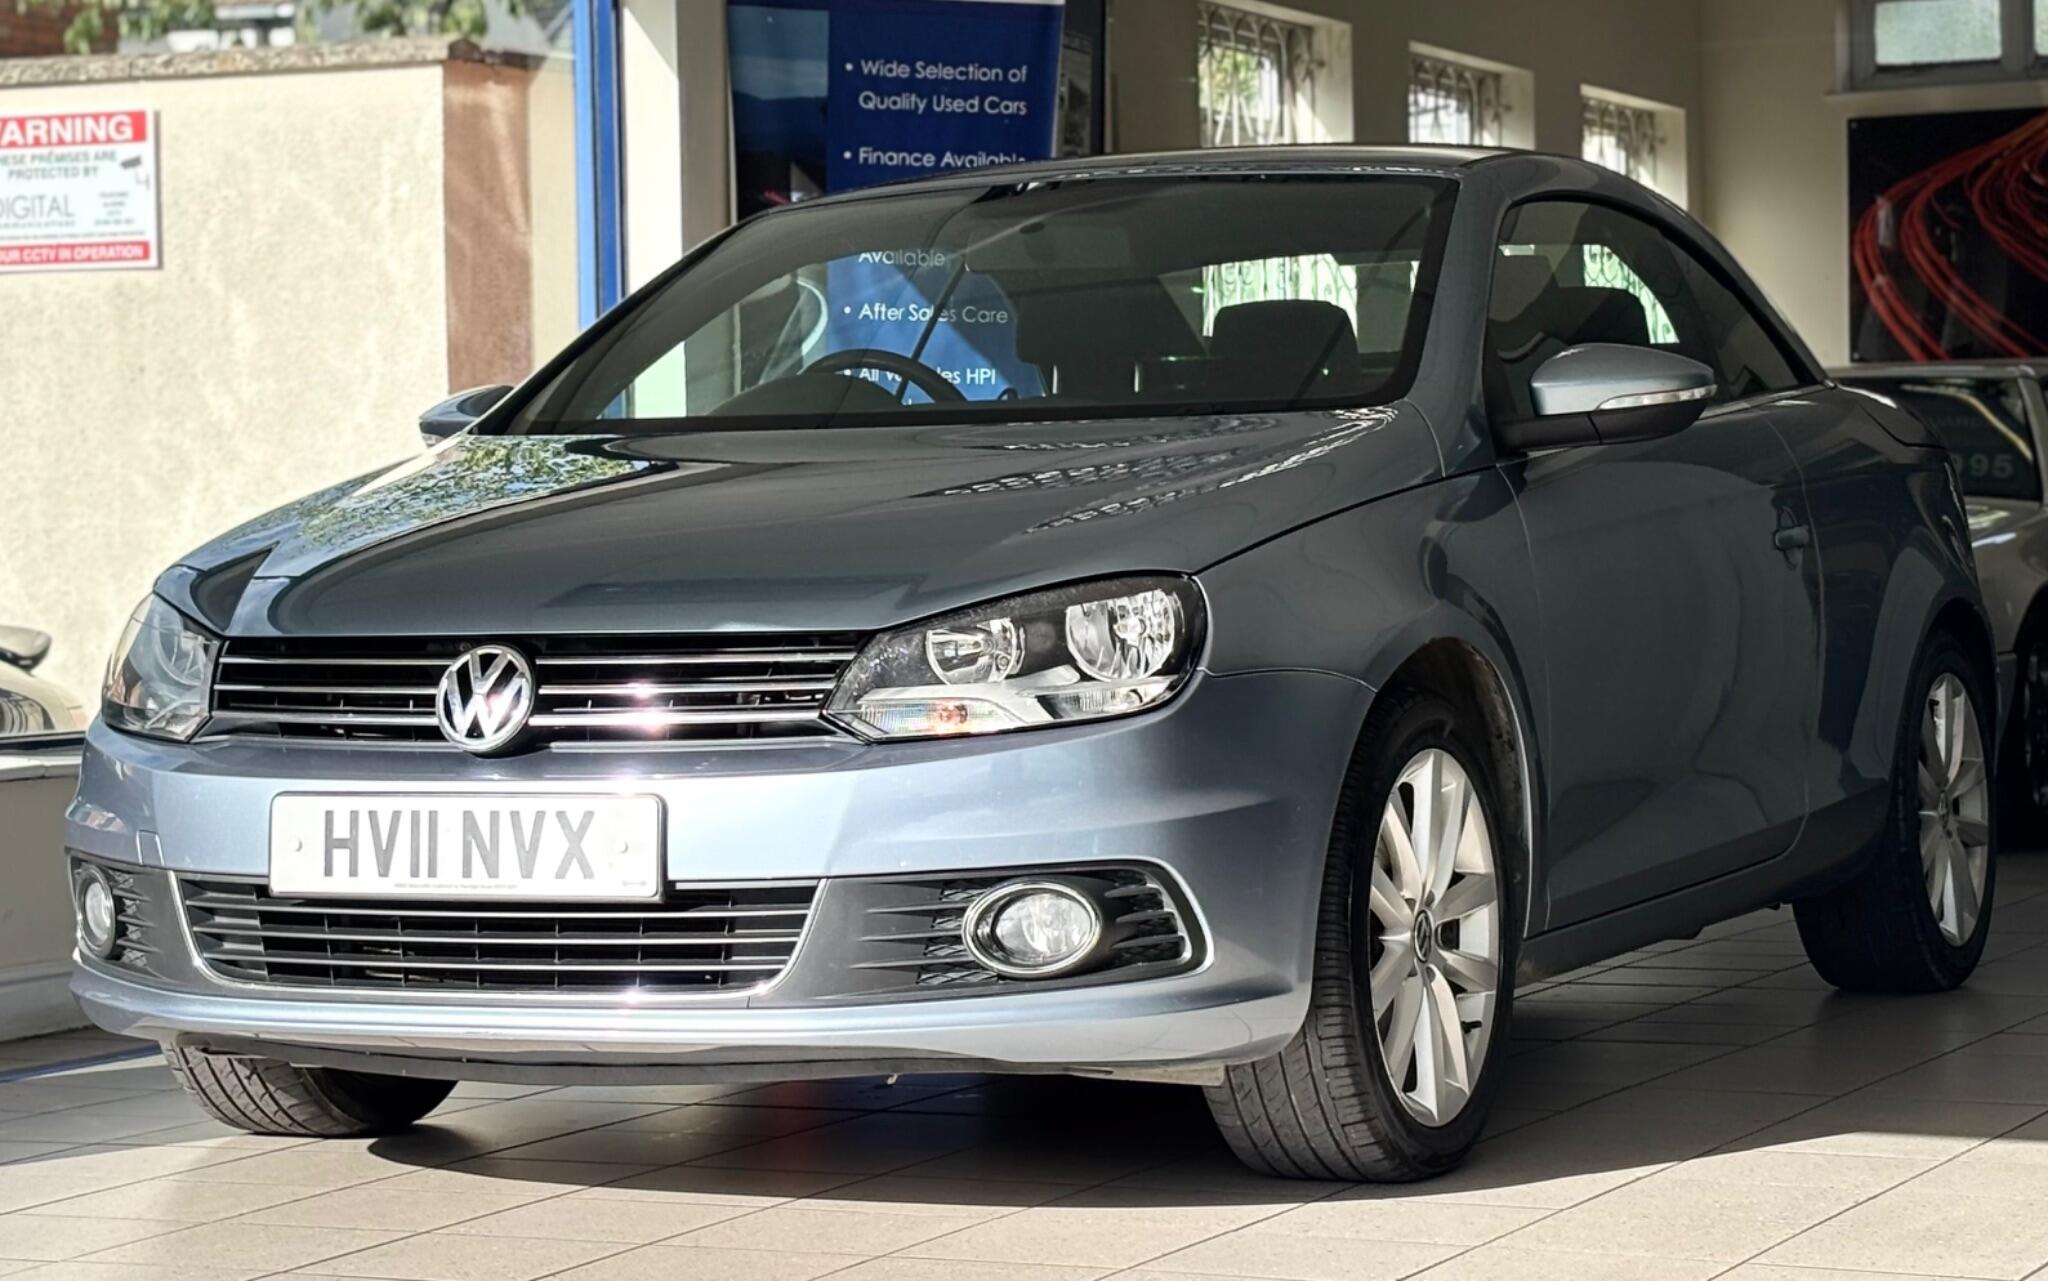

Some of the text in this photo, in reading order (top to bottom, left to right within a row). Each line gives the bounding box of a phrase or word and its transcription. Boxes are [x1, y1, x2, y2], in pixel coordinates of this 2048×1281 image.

[860, 59, 1029, 83] Wide Selection of
[858, 91, 1028, 115] Quality Used Cars
[0, 113, 134, 147] ARNING
[94, 150, 117, 162] ARE
[858, 147, 935, 167] Finance
[8, 166, 99, 180] PROTECTED BY
[22, 248, 56, 262] CCTV
[58, 246, 71, 260] IN
[73, 244, 144, 259] OPERATION
[858, 303, 905, 320] After
[962, 305, 1008, 323] Care
[859, 367, 880, 382] All
[966, 368, 996, 385] HPI
[461, 810, 595, 879] NVX
